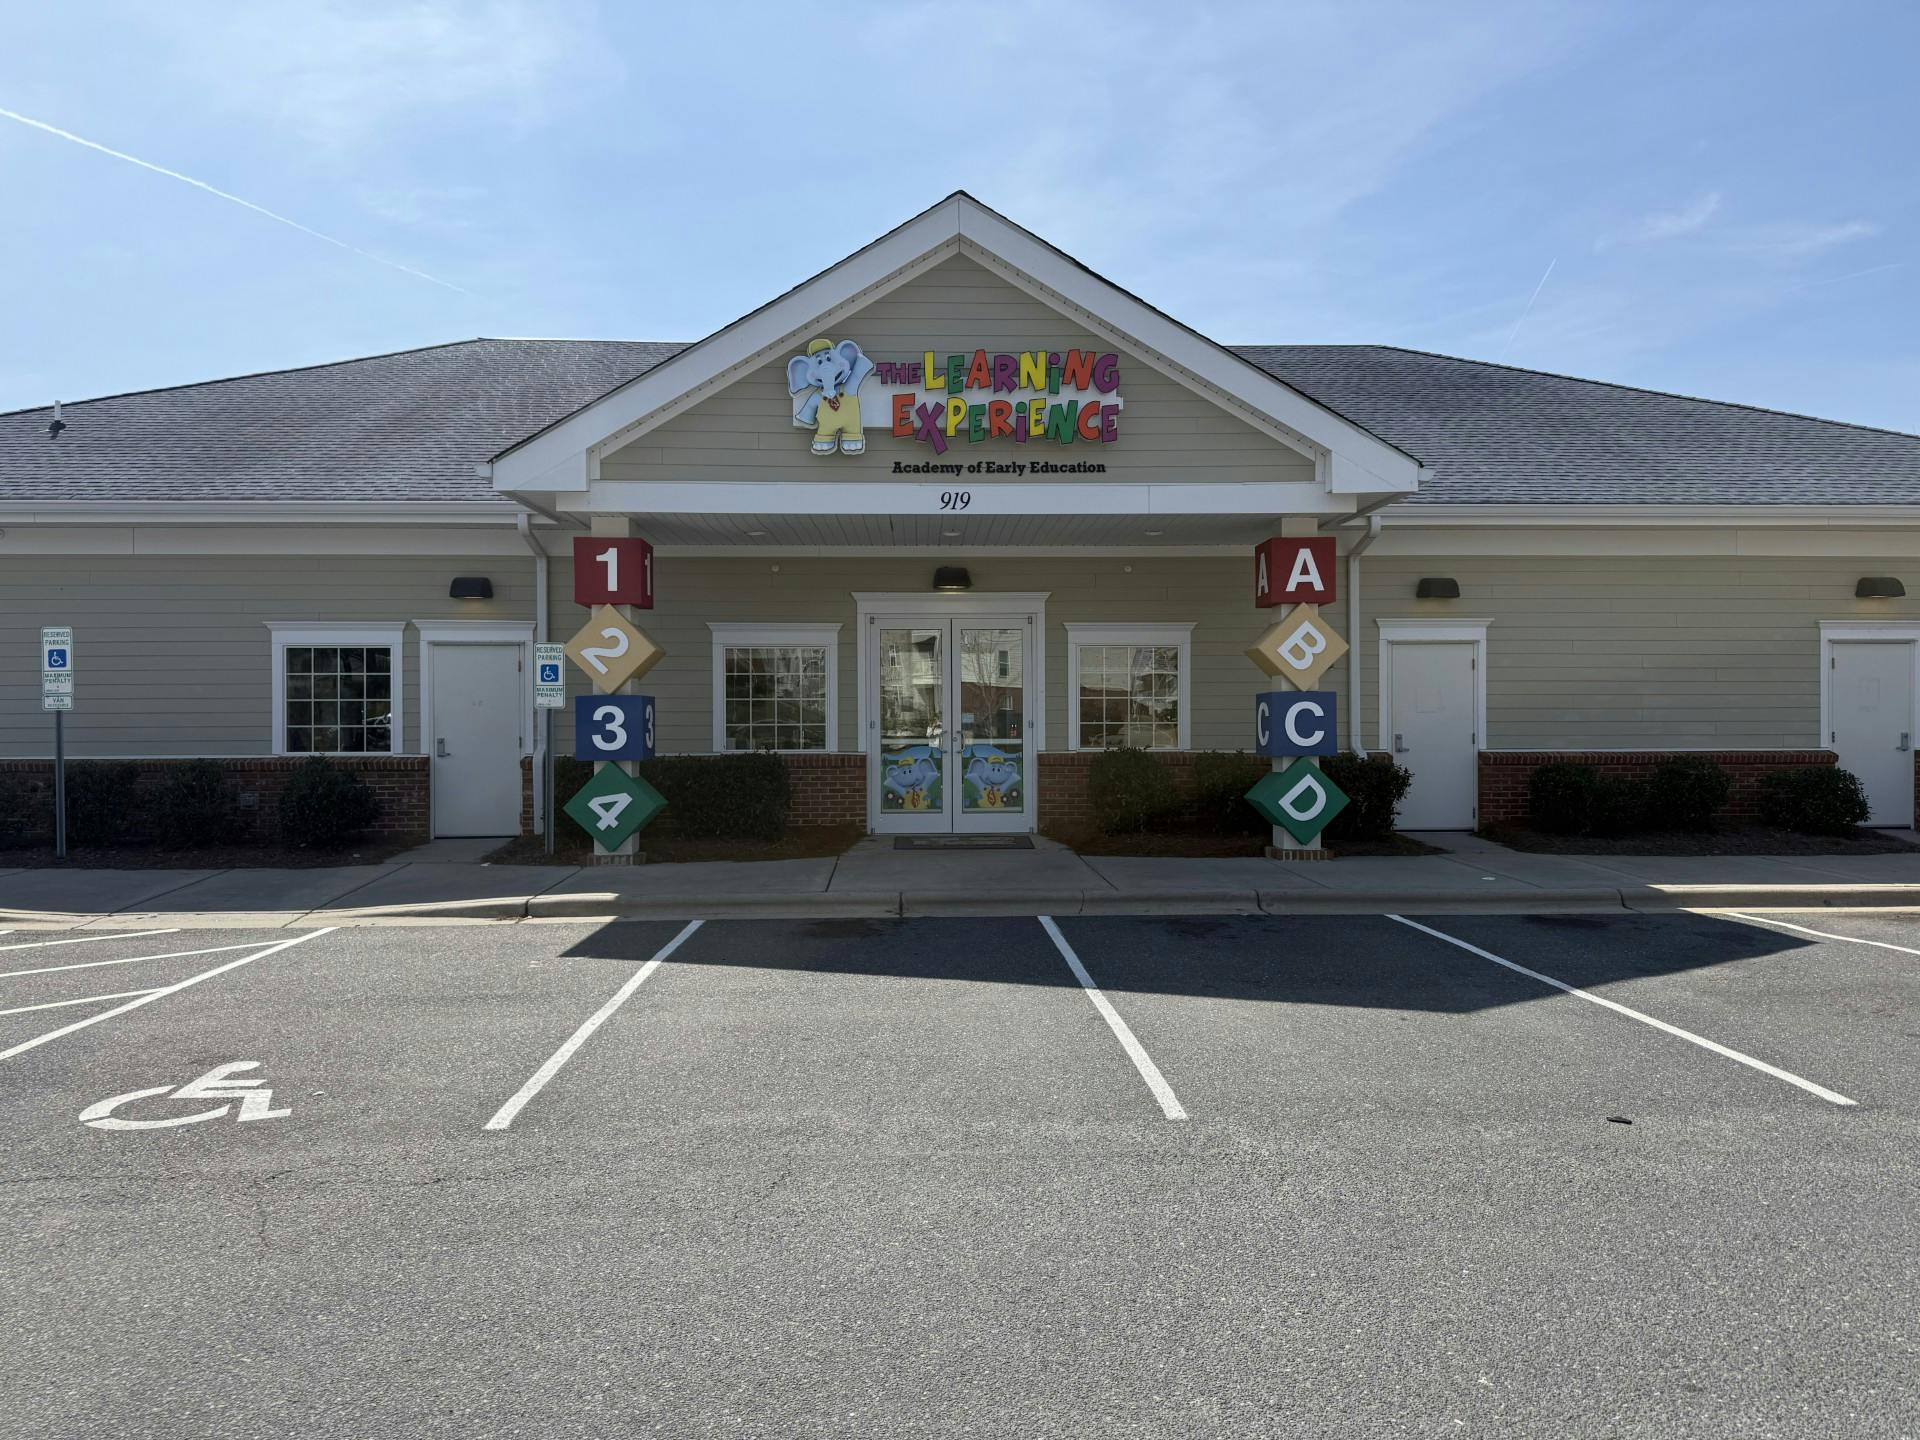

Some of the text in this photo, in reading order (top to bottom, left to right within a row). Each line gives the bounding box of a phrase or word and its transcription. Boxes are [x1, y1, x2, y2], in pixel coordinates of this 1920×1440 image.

[876, 362, 921, 385] THE
[892, 461, 1106, 476] Academy of Early Education
[939, 491, 971, 510] 919
[595, 547, 618, 592] 1
[1257, 552, 1269, 597] A
[1285, 548, 1325, 592] A
[536, 646, 563, 654] RESERVED
[580, 627, 629, 675] 2
[1276, 620, 1326, 670] B
[591, 705, 627, 750] 3
[1257, 701, 1270, 747] C
[1285, 701, 1325, 747] C
[587, 792, 632, 831] 4
[1278, 773, 1327, 821] D
